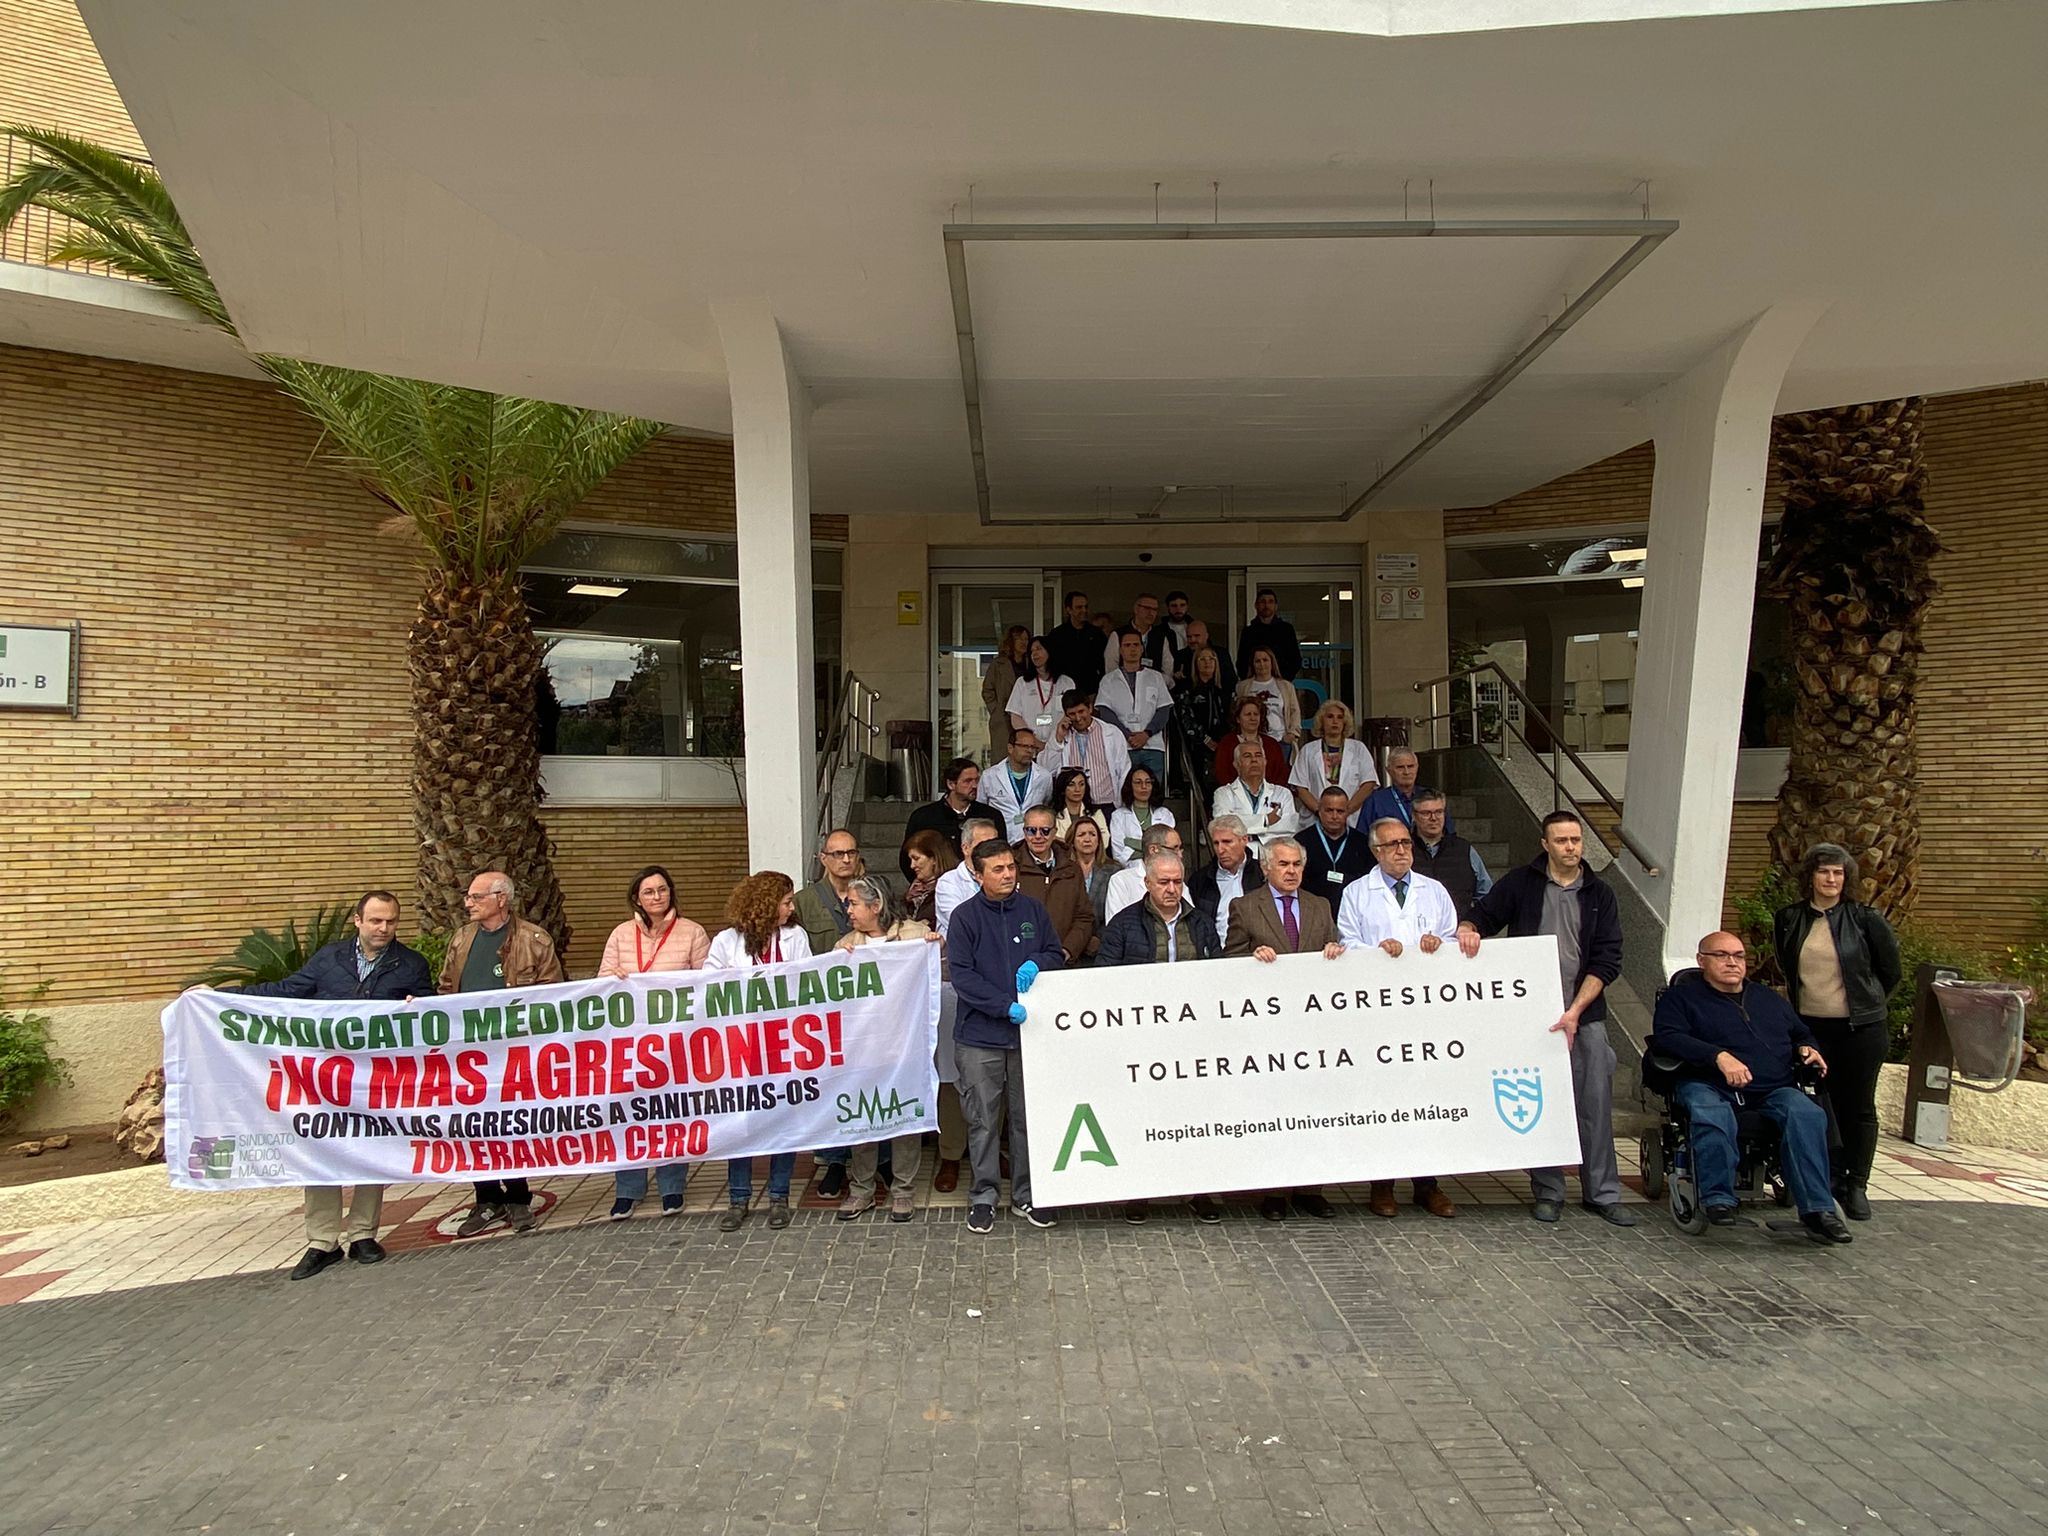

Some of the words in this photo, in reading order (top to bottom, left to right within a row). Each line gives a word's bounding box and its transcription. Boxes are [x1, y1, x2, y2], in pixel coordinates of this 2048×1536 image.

[35, 675, 47, 689] B
[219, 1008, 450, 1050] SINDICATO
[463, 991, 634, 1043] MÉDICO
[647, 986, 695, 1025] DE
[705, 961, 885, 1018] MÁLAGA
[1055, 1003, 1197, 1031] CONTRA
[1220, 996, 1281, 1019] LAS
[1305, 979, 1528, 1014] AGRESIONES
[266, 1055, 355, 1112] ¡NO
[368, 1048, 488, 1109] MÁS
[500, 1011, 844, 1103] AGRESIONES!
[1126, 1048, 1354, 1083] TOLERANCIA
[1376, 1040, 1465, 1064] CERO
[293, 1112, 398, 1139] CONTRA
[397, 1115, 443, 1138] LAS
[449, 1103, 604, 1138] AGRESIONES
[609, 1101, 628, 1125] A
[632, 1076, 821, 1122] SANITARIAS-OS
[837, 1085, 919, 1125] SMA
[1145, 1122, 1211, 1143] Hospital
[1214, 1117, 1283, 1139] Regional
[1285, 1109, 1387, 1132] Universitario
[1391, 1108, 1410, 1123] de
[1413, 1104, 1470, 1125] Málaga
[239, 1132, 296, 1147] SINDICATO
[239, 1147, 282, 1162] MÉDICO
[410, 1129, 617, 1174] TOLERANCIA
[625, 1119, 710, 1162] CERO
[238, 1163, 286, 1178] MÁLAGA
